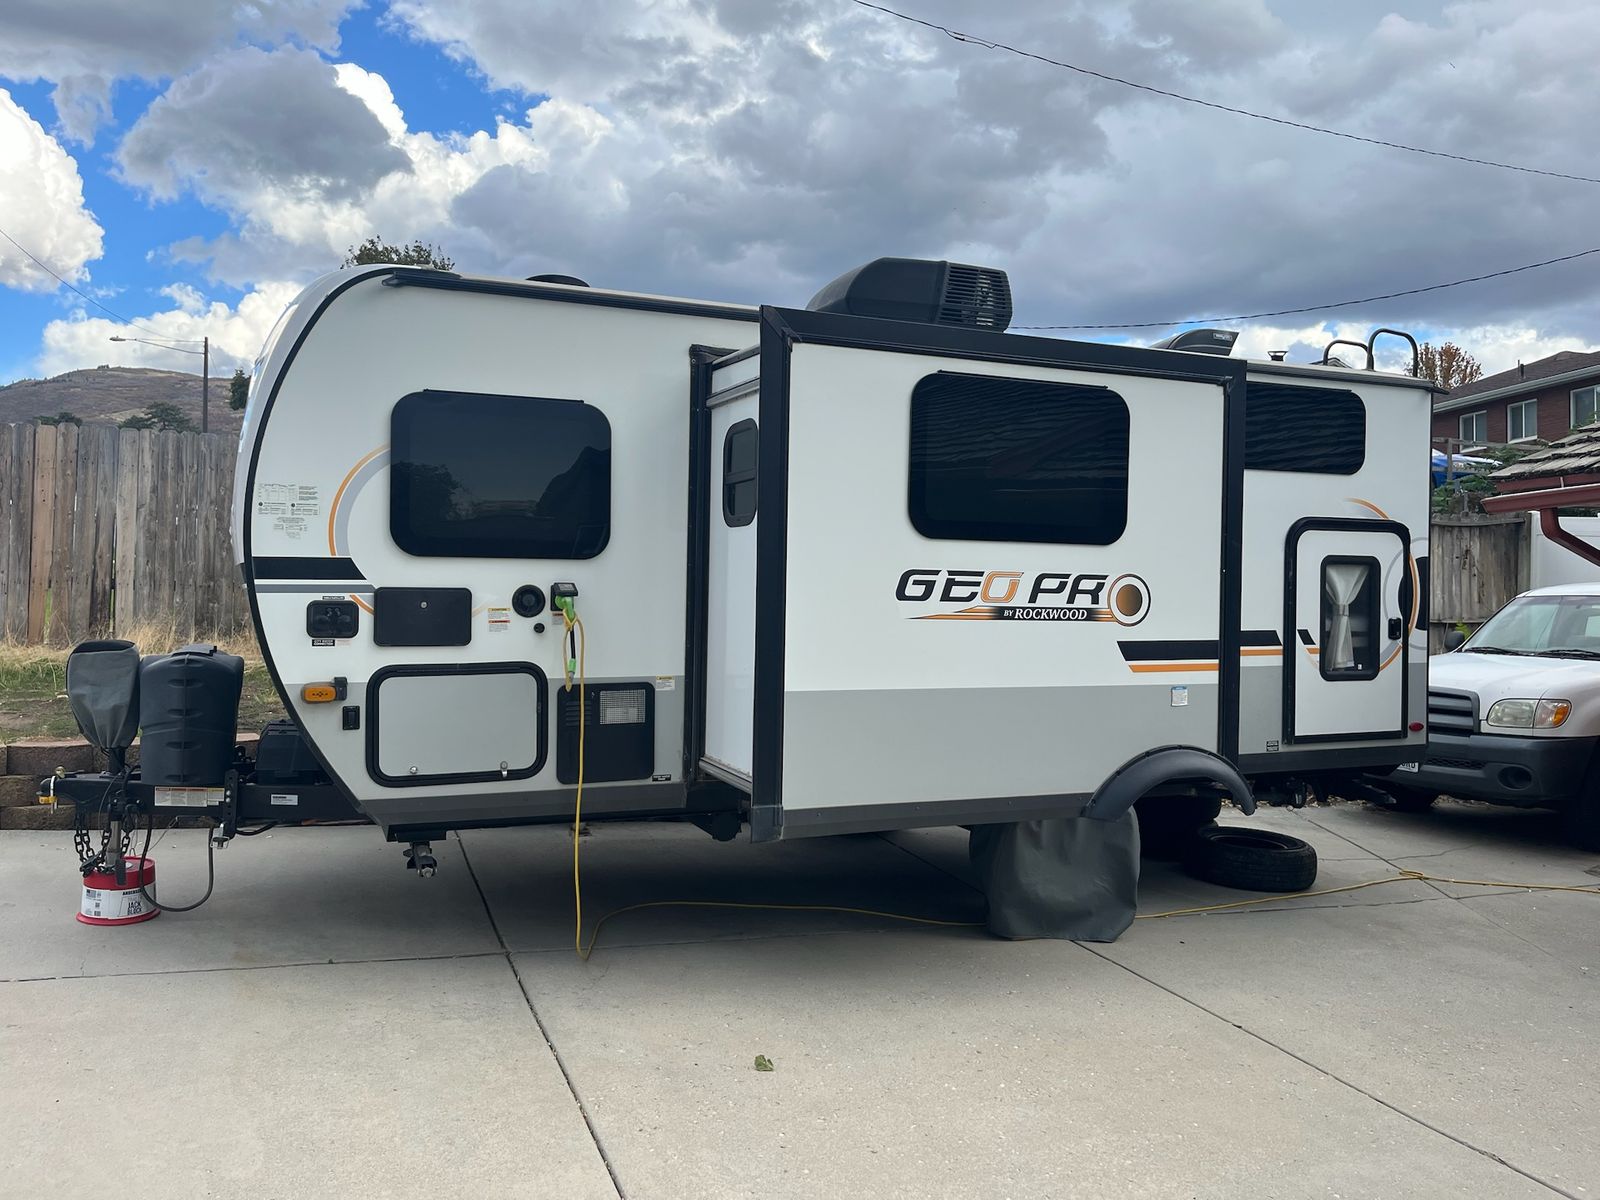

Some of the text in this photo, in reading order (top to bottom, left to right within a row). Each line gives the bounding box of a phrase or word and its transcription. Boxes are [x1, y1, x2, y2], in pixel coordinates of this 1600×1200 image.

[895, 568, 1151, 627] GEO PRO
[1003, 608, 1088, 620] BY ROCKWOOD
